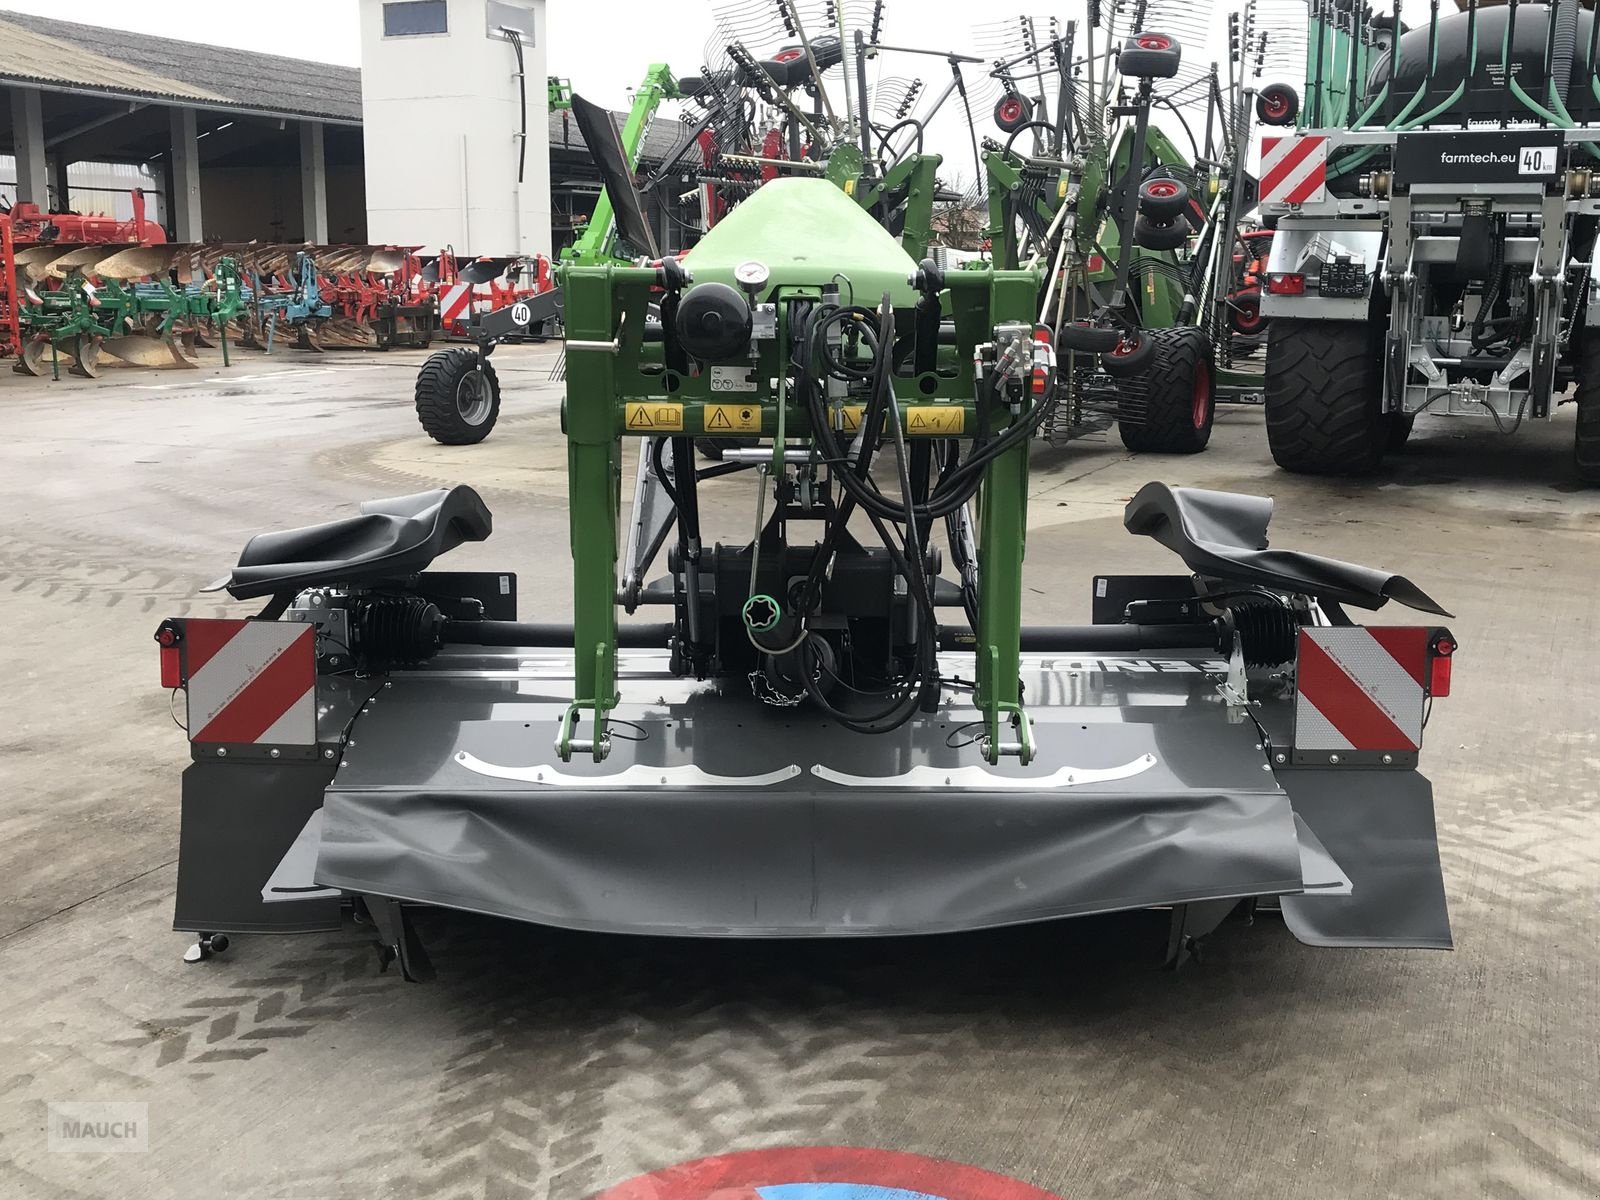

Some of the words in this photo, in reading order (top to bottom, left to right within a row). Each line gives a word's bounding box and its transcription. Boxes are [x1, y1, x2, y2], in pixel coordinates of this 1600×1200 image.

[1441, 152, 1516, 163] farmtech.eu
[1523, 150, 1542, 171] 40
[1542, 161, 1553, 171] km
[514, 306, 527, 322] 40
[1020, 660, 1230, 673] FEND
